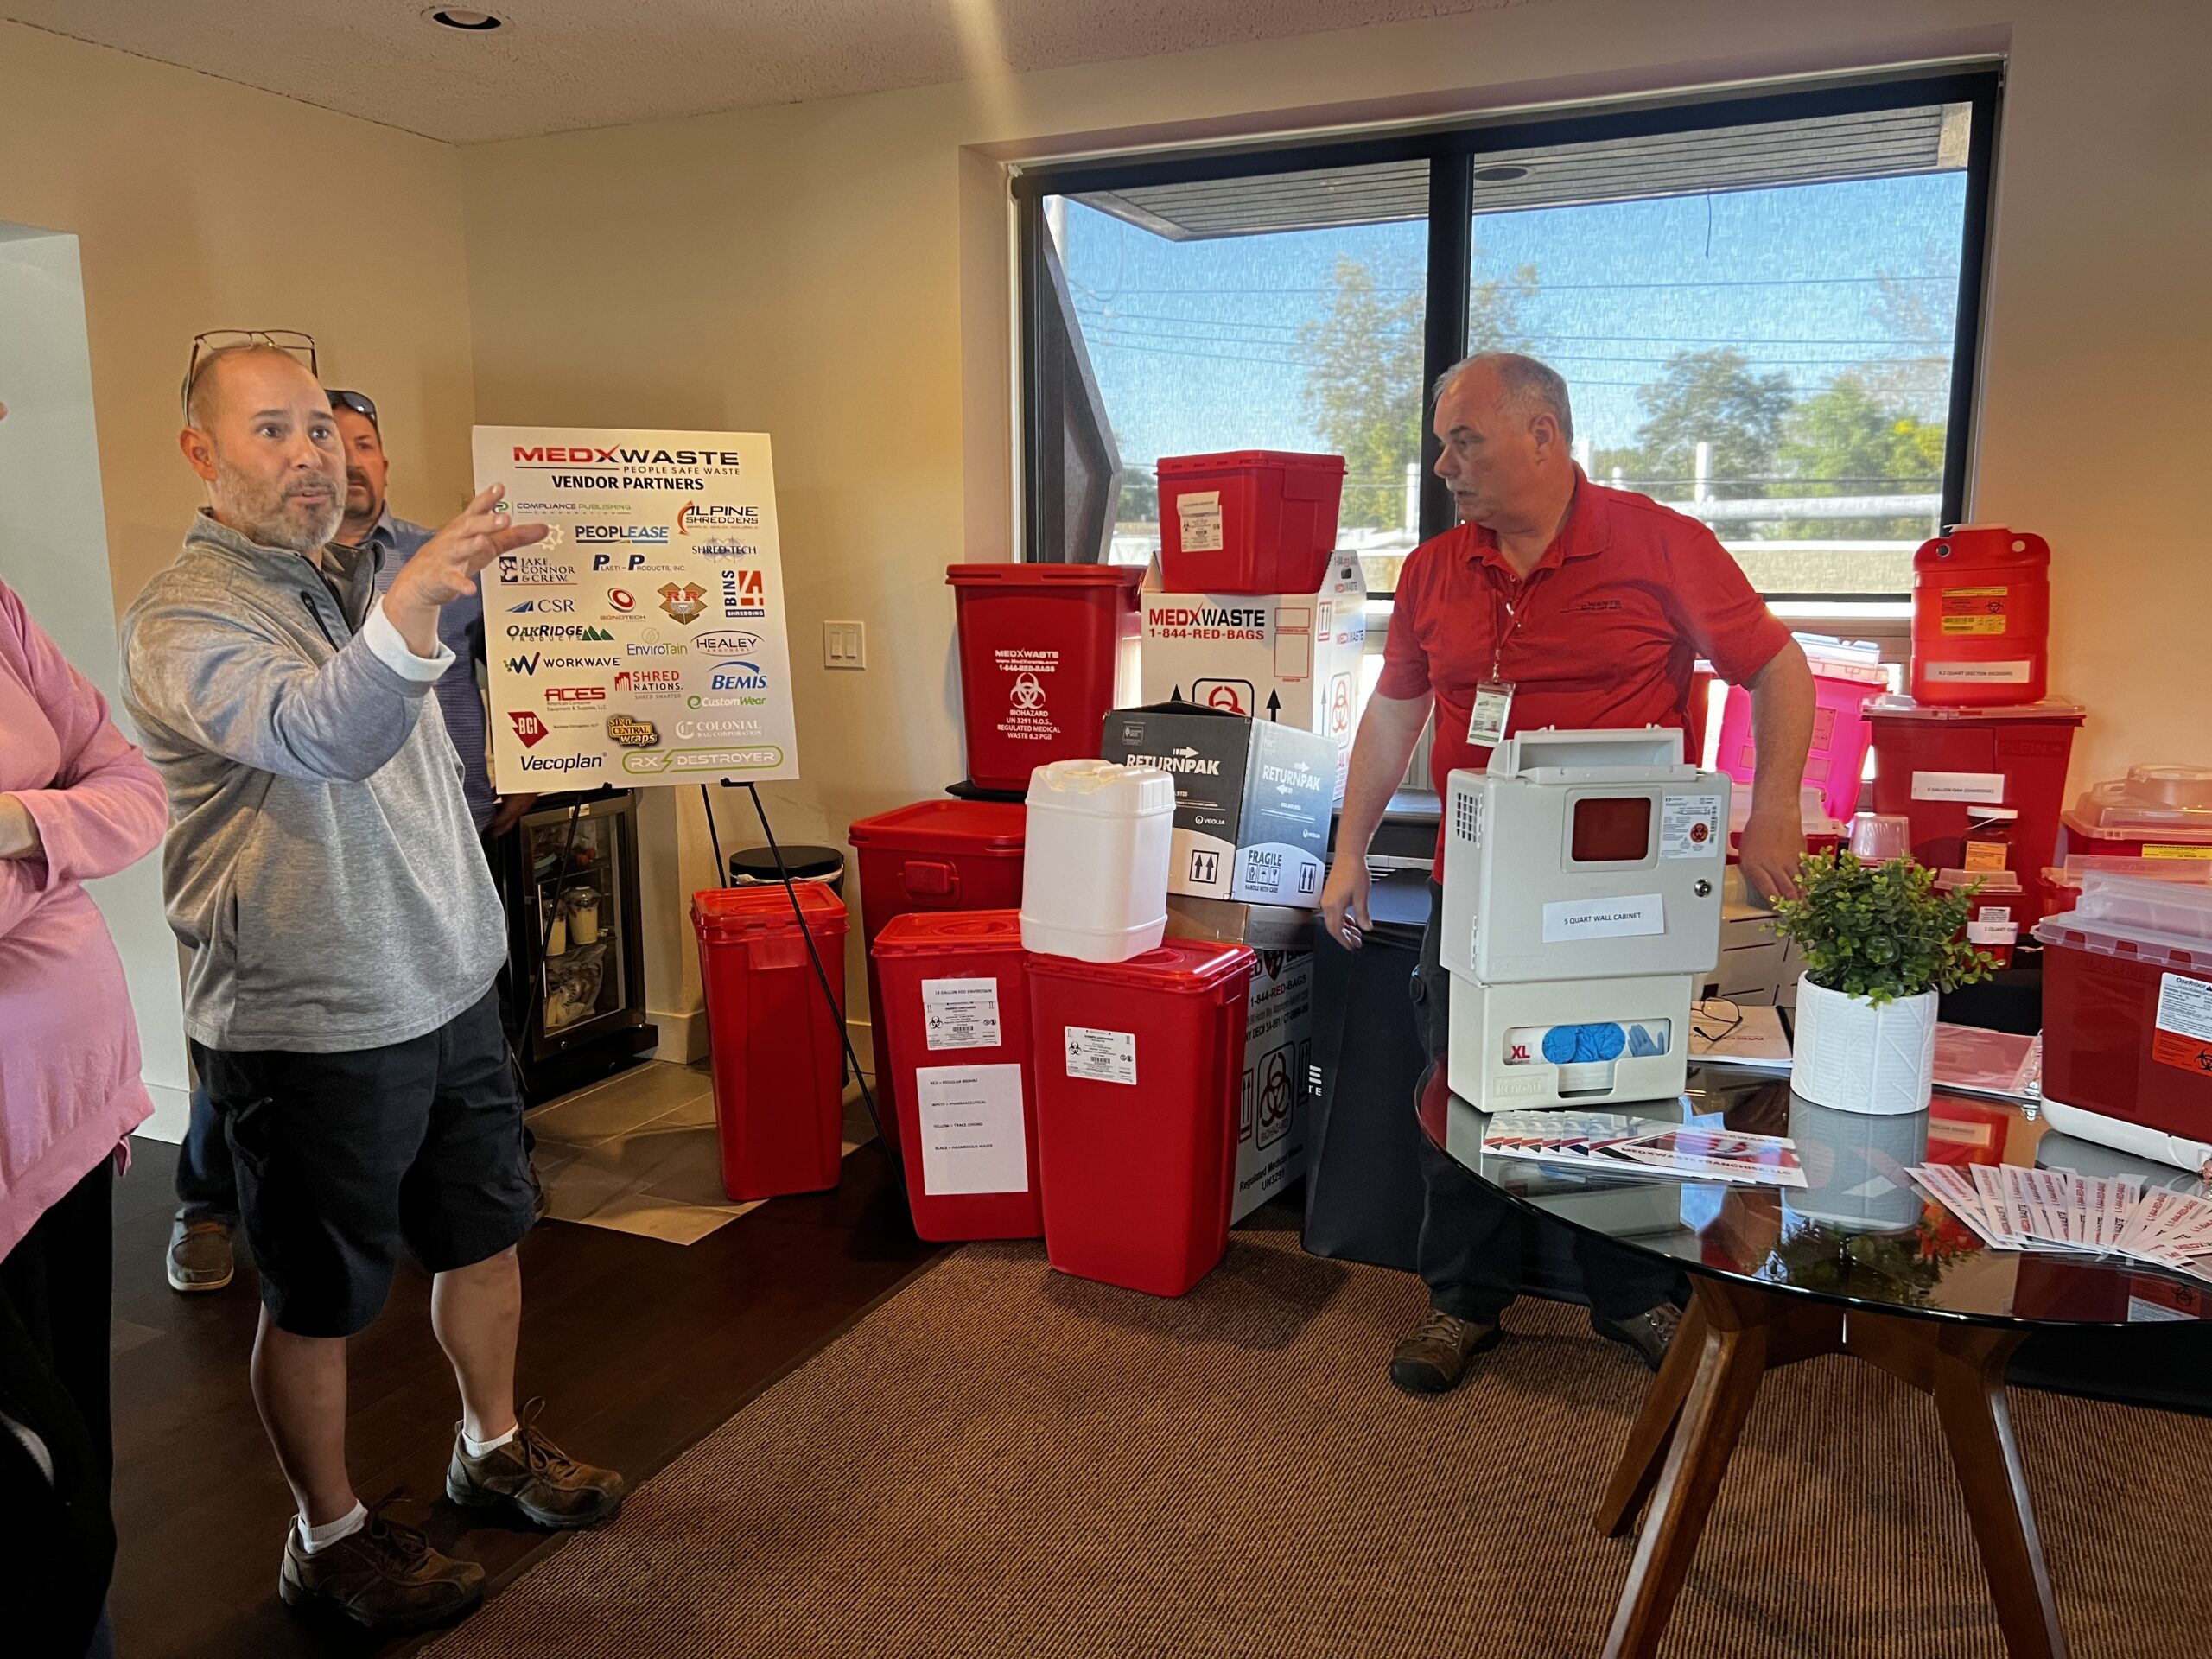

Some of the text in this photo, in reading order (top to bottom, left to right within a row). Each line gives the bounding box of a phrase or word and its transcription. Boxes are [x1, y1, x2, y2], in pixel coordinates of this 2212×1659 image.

[513, 443, 740, 465] MEDXWASTE
[624, 466, 667, 474] PEOPLE
[551, 475, 705, 490] VENDOR PARTNERS
[685, 505, 759, 516] ALPINE
[575, 525, 670, 538] PEOPLEASE
[691, 545, 757, 555] SHRED-TECH
[521, 566, 576, 575] CONNOR
[721, 570, 737, 607] BINS
[537, 599, 575, 613] CSR
[1149, 602, 1266, 627] MEDXWASTE
[1149, 628, 1265, 640] 1-844-RED-BAGS
[626, 642, 688, 656] EnviroTain
[696, 638, 758, 649] HEALEY
[995, 648, 1059, 658] MEDXWASTE
[543, 657, 620, 668] WORKWAVE
[632, 671, 680, 683] SHRED
[711, 674, 767, 690] BEMIS
[544, 687, 607, 702] ACES
[518, 717, 538, 734] BCI
[608, 716, 632, 727] sign
[696, 720, 761, 732] COLONIAL
[613, 726, 650, 734] CENTRAL
[1033, 725, 1061, 734] MEDICAL
[620, 734, 657, 746] wraps
[630, 752, 775, 768] RX DESTROYER
[1126, 753, 1221, 776] RETURNPAK
[1262, 764, 1322, 791] RETURNPAK
[1248, 849, 1283, 867] FRAGILE
[1569, 915, 1592, 925] QUART
[1613, 912, 1642, 921] CABINET
[1250, 973, 1307, 1007] 1-844-RED-BAGS
[1510, 1045, 1531, 1060] XL
[1239, 1166, 1267, 1192] Regulated
[1262, 1167, 1286, 1192] UN3291
